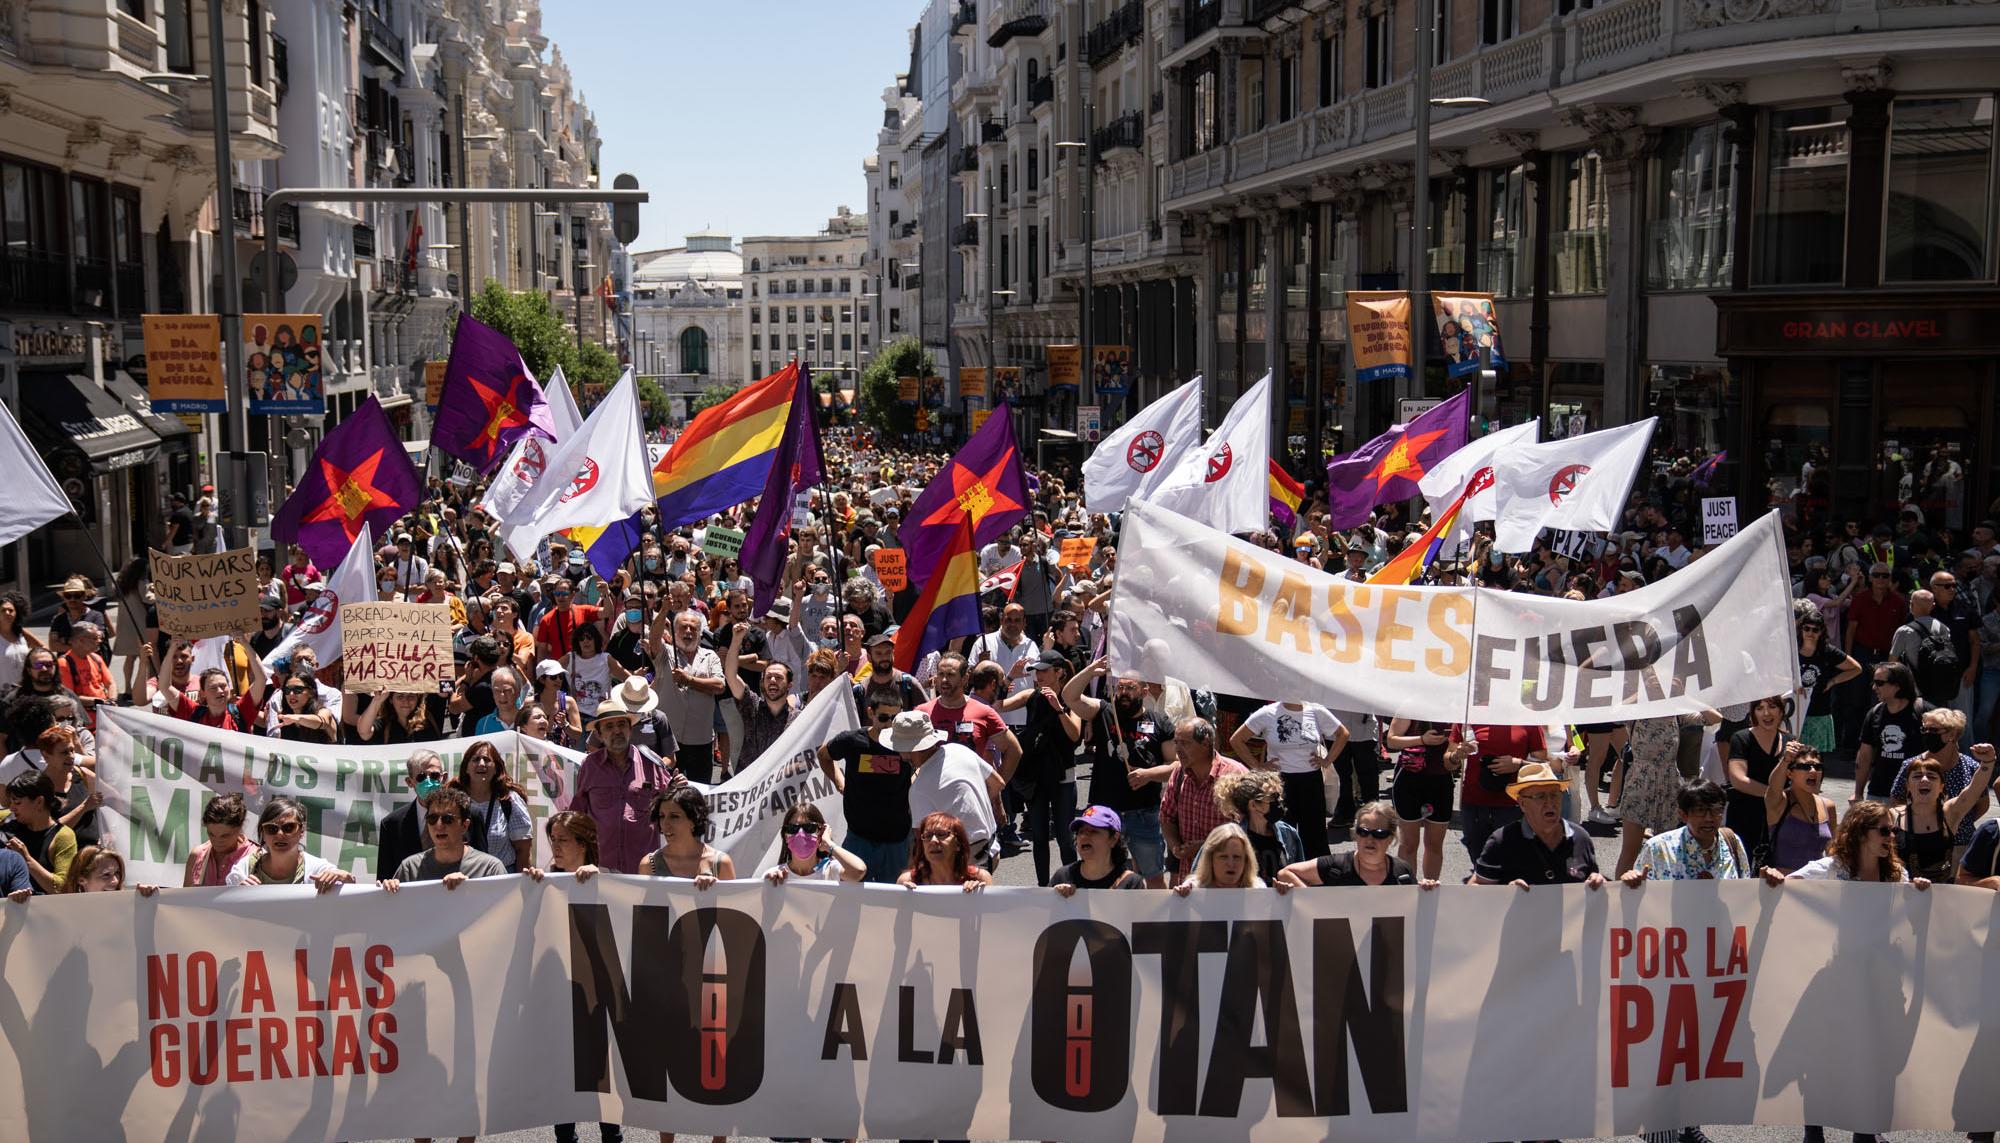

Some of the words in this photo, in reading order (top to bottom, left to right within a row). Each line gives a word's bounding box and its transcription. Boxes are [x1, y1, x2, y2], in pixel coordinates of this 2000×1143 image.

[1783, 321, 1847, 338] GRAN
[1853, 320, 1941, 338] CLAVEL
[170, 334, 199, 348] DÍA
[151, 351, 218, 362] EUROPEO
[165, 363, 185, 373] DE
[190, 363, 208, 373] LA
[160, 372, 214, 386] MÚSICA
[180, 403, 209, 411] MADRID
[454, 463, 472, 479] NO
[1706, 501, 1732, 517] JUST
[709, 531, 742, 545] ACUERDO
[1704, 522, 1739, 541] PEACE!
[1554, 527, 1587, 558] PAZ
[150, 551, 196, 580] YOUR
[197, 553, 254, 579] WARS
[879, 554, 900, 564] JUST
[876, 566, 904, 576] PEACE
[154, 580, 186, 602] OUR
[190, 578, 246, 601] LIVES
[343, 607, 392, 624] BREAD
[400, 609, 446, 625] WORK
[1216, 545, 1475, 677] BASES
[343, 627, 394, 642] PAPERS
[410, 630, 443, 642] ALL
[1472, 603, 1714, 712] FUERA
[345, 660, 454, 682] MASSACRE
[132, 735, 185, 781] NO
[199, 742, 226, 784] A
[243, 746, 319, 790] LOS
[722, 806, 755, 839] LAS
[1609, 926, 1691, 979] POR
[1706, 925, 1749, 977] LA
[147, 950, 219, 1020] NO
[241, 950, 276, 1013] A
[295, 944, 396, 1012] LAS
[567, 903, 767, 1106] NO
[820, 982, 869, 1061] A
[897, 985, 985, 1066] LA
[1030, 915, 1409, 1118] OTAN
[1609, 979, 1748, 1089] PAZ
[149, 1011, 400, 1088] GUERRAS
